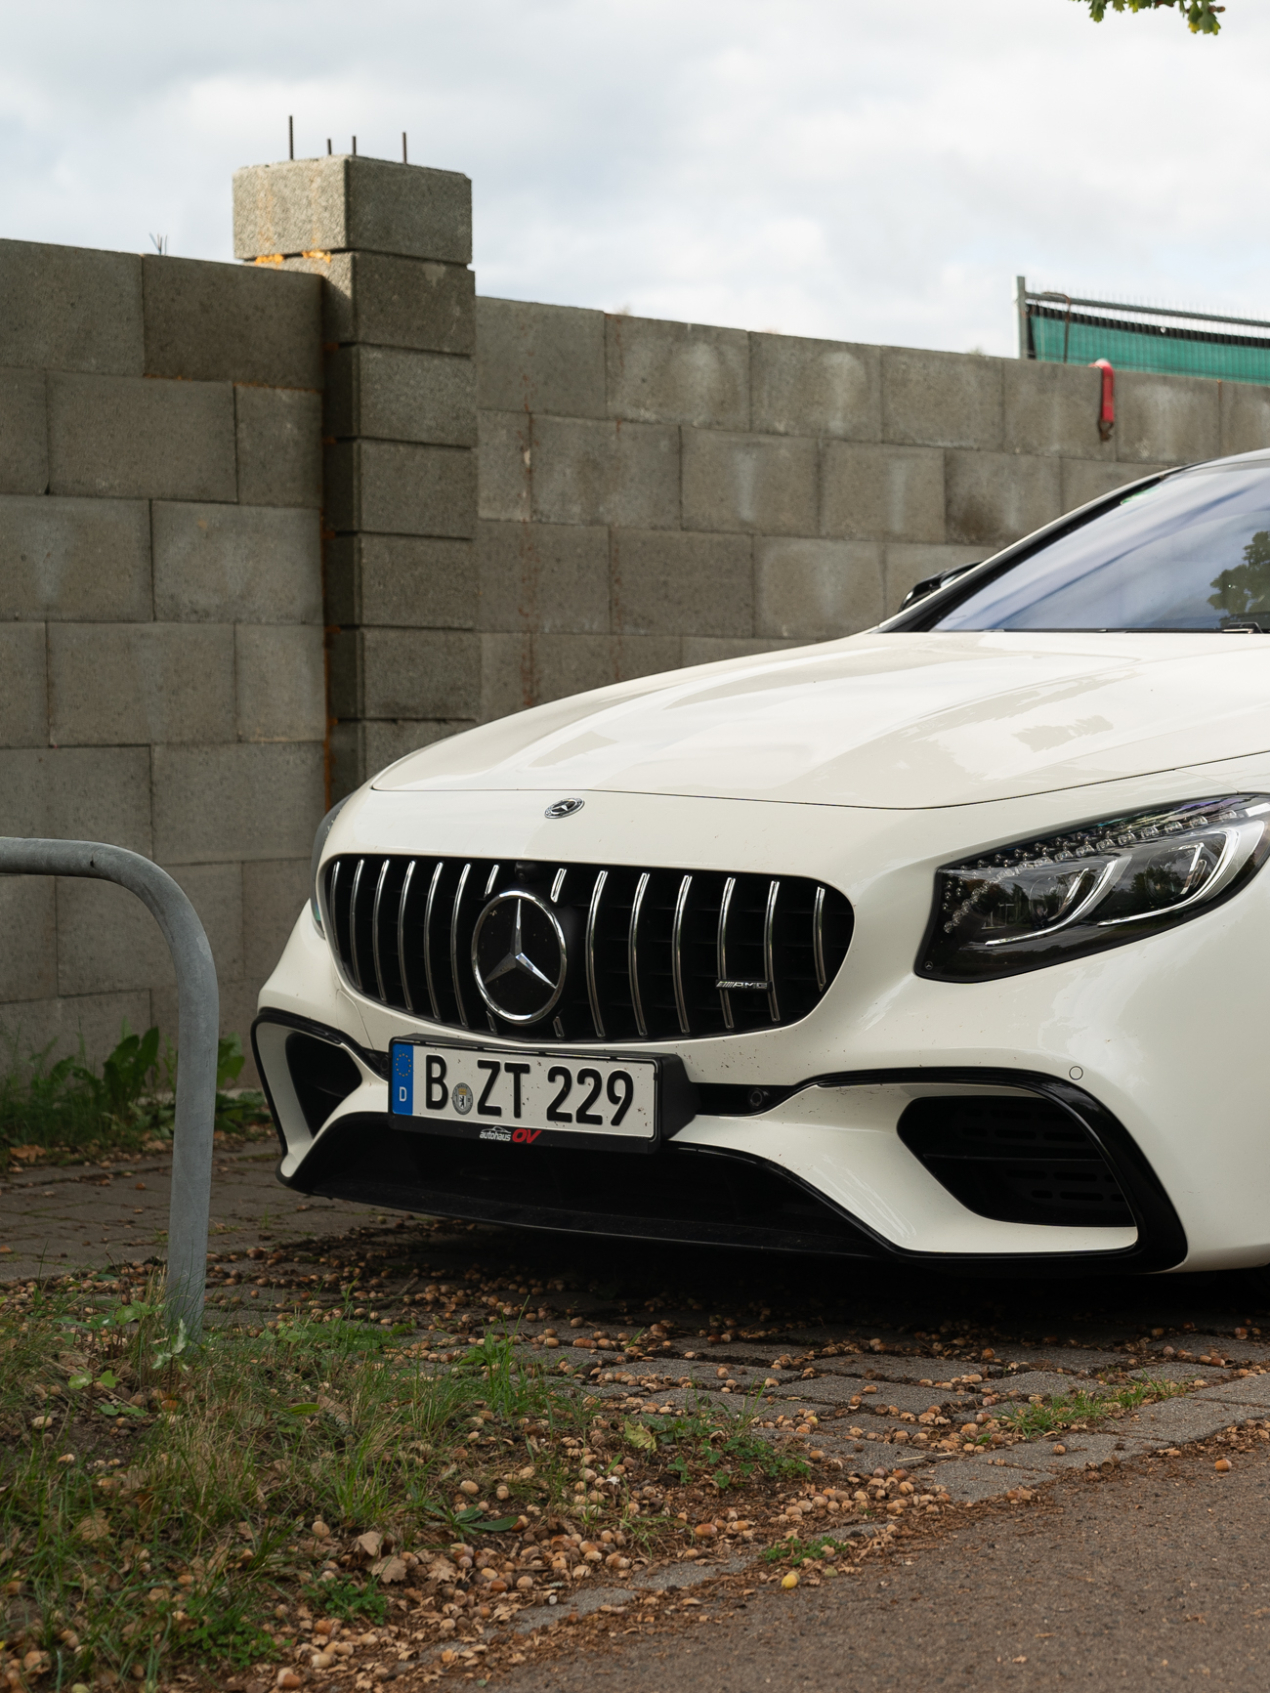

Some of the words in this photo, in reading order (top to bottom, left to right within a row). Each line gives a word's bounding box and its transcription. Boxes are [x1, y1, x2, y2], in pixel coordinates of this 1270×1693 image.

[399, 1086, 407, 1102] D
[426, 1054, 449, 1110] B
[477, 1059, 531, 1119] ZT
[546, 1066, 634, 1126] 229
[479, 1130, 511, 1141] autohaus
[512, 1128, 542, 1143] OV
